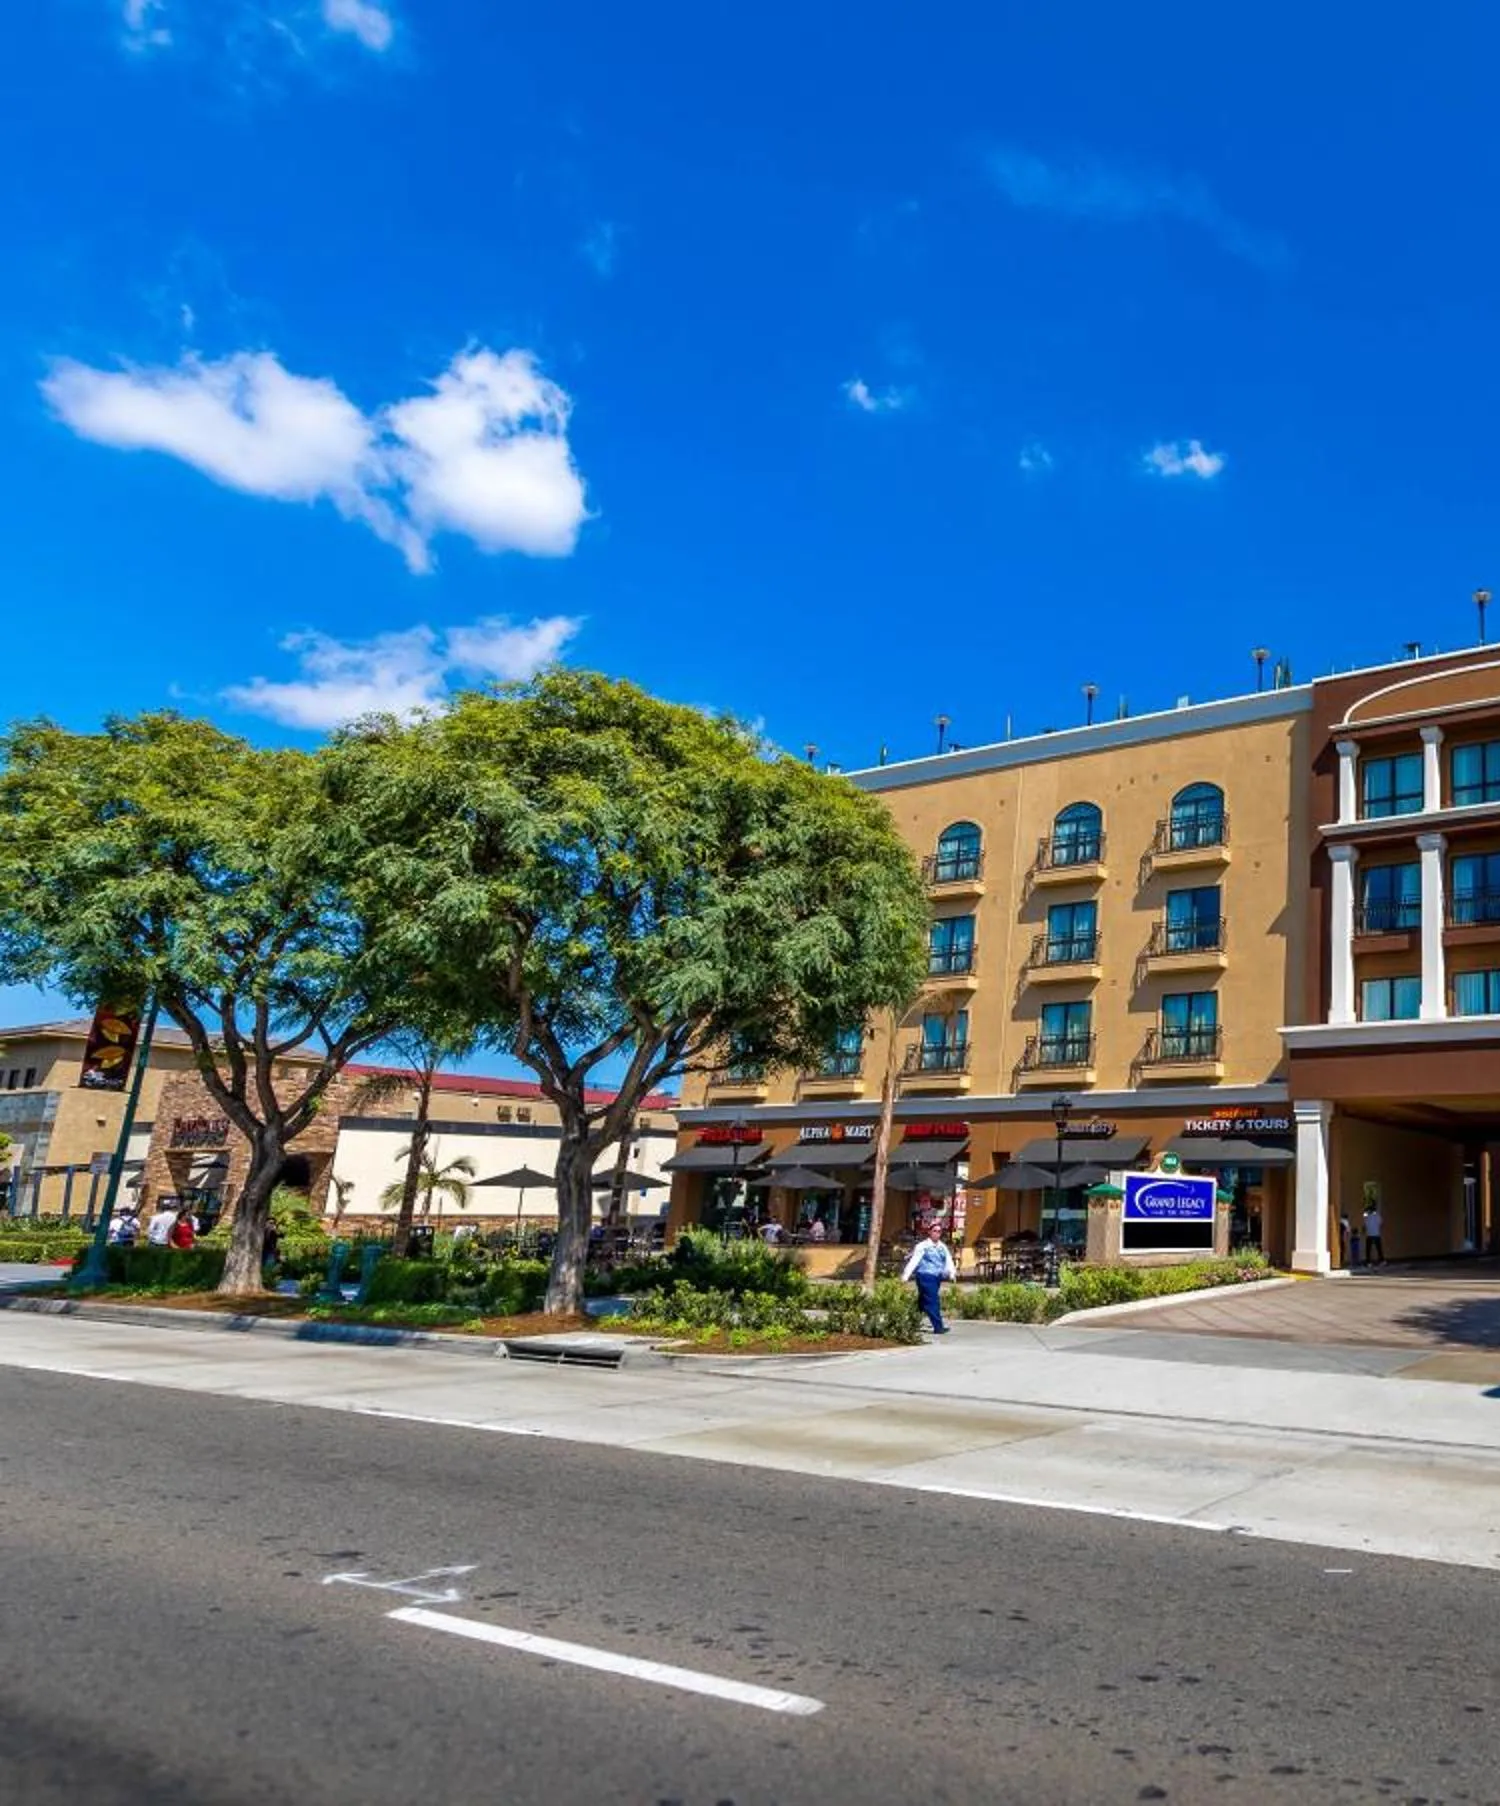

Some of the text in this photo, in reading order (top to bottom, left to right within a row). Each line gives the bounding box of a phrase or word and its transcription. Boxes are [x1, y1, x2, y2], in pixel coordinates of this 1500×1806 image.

[799, 1125, 873, 1139] ALPHA MART
[1186, 1119, 1232, 1131] TICKETS
[1246, 1119, 1290, 1129] TOURS
[1177, 1195, 1206, 1209] LEGACY
